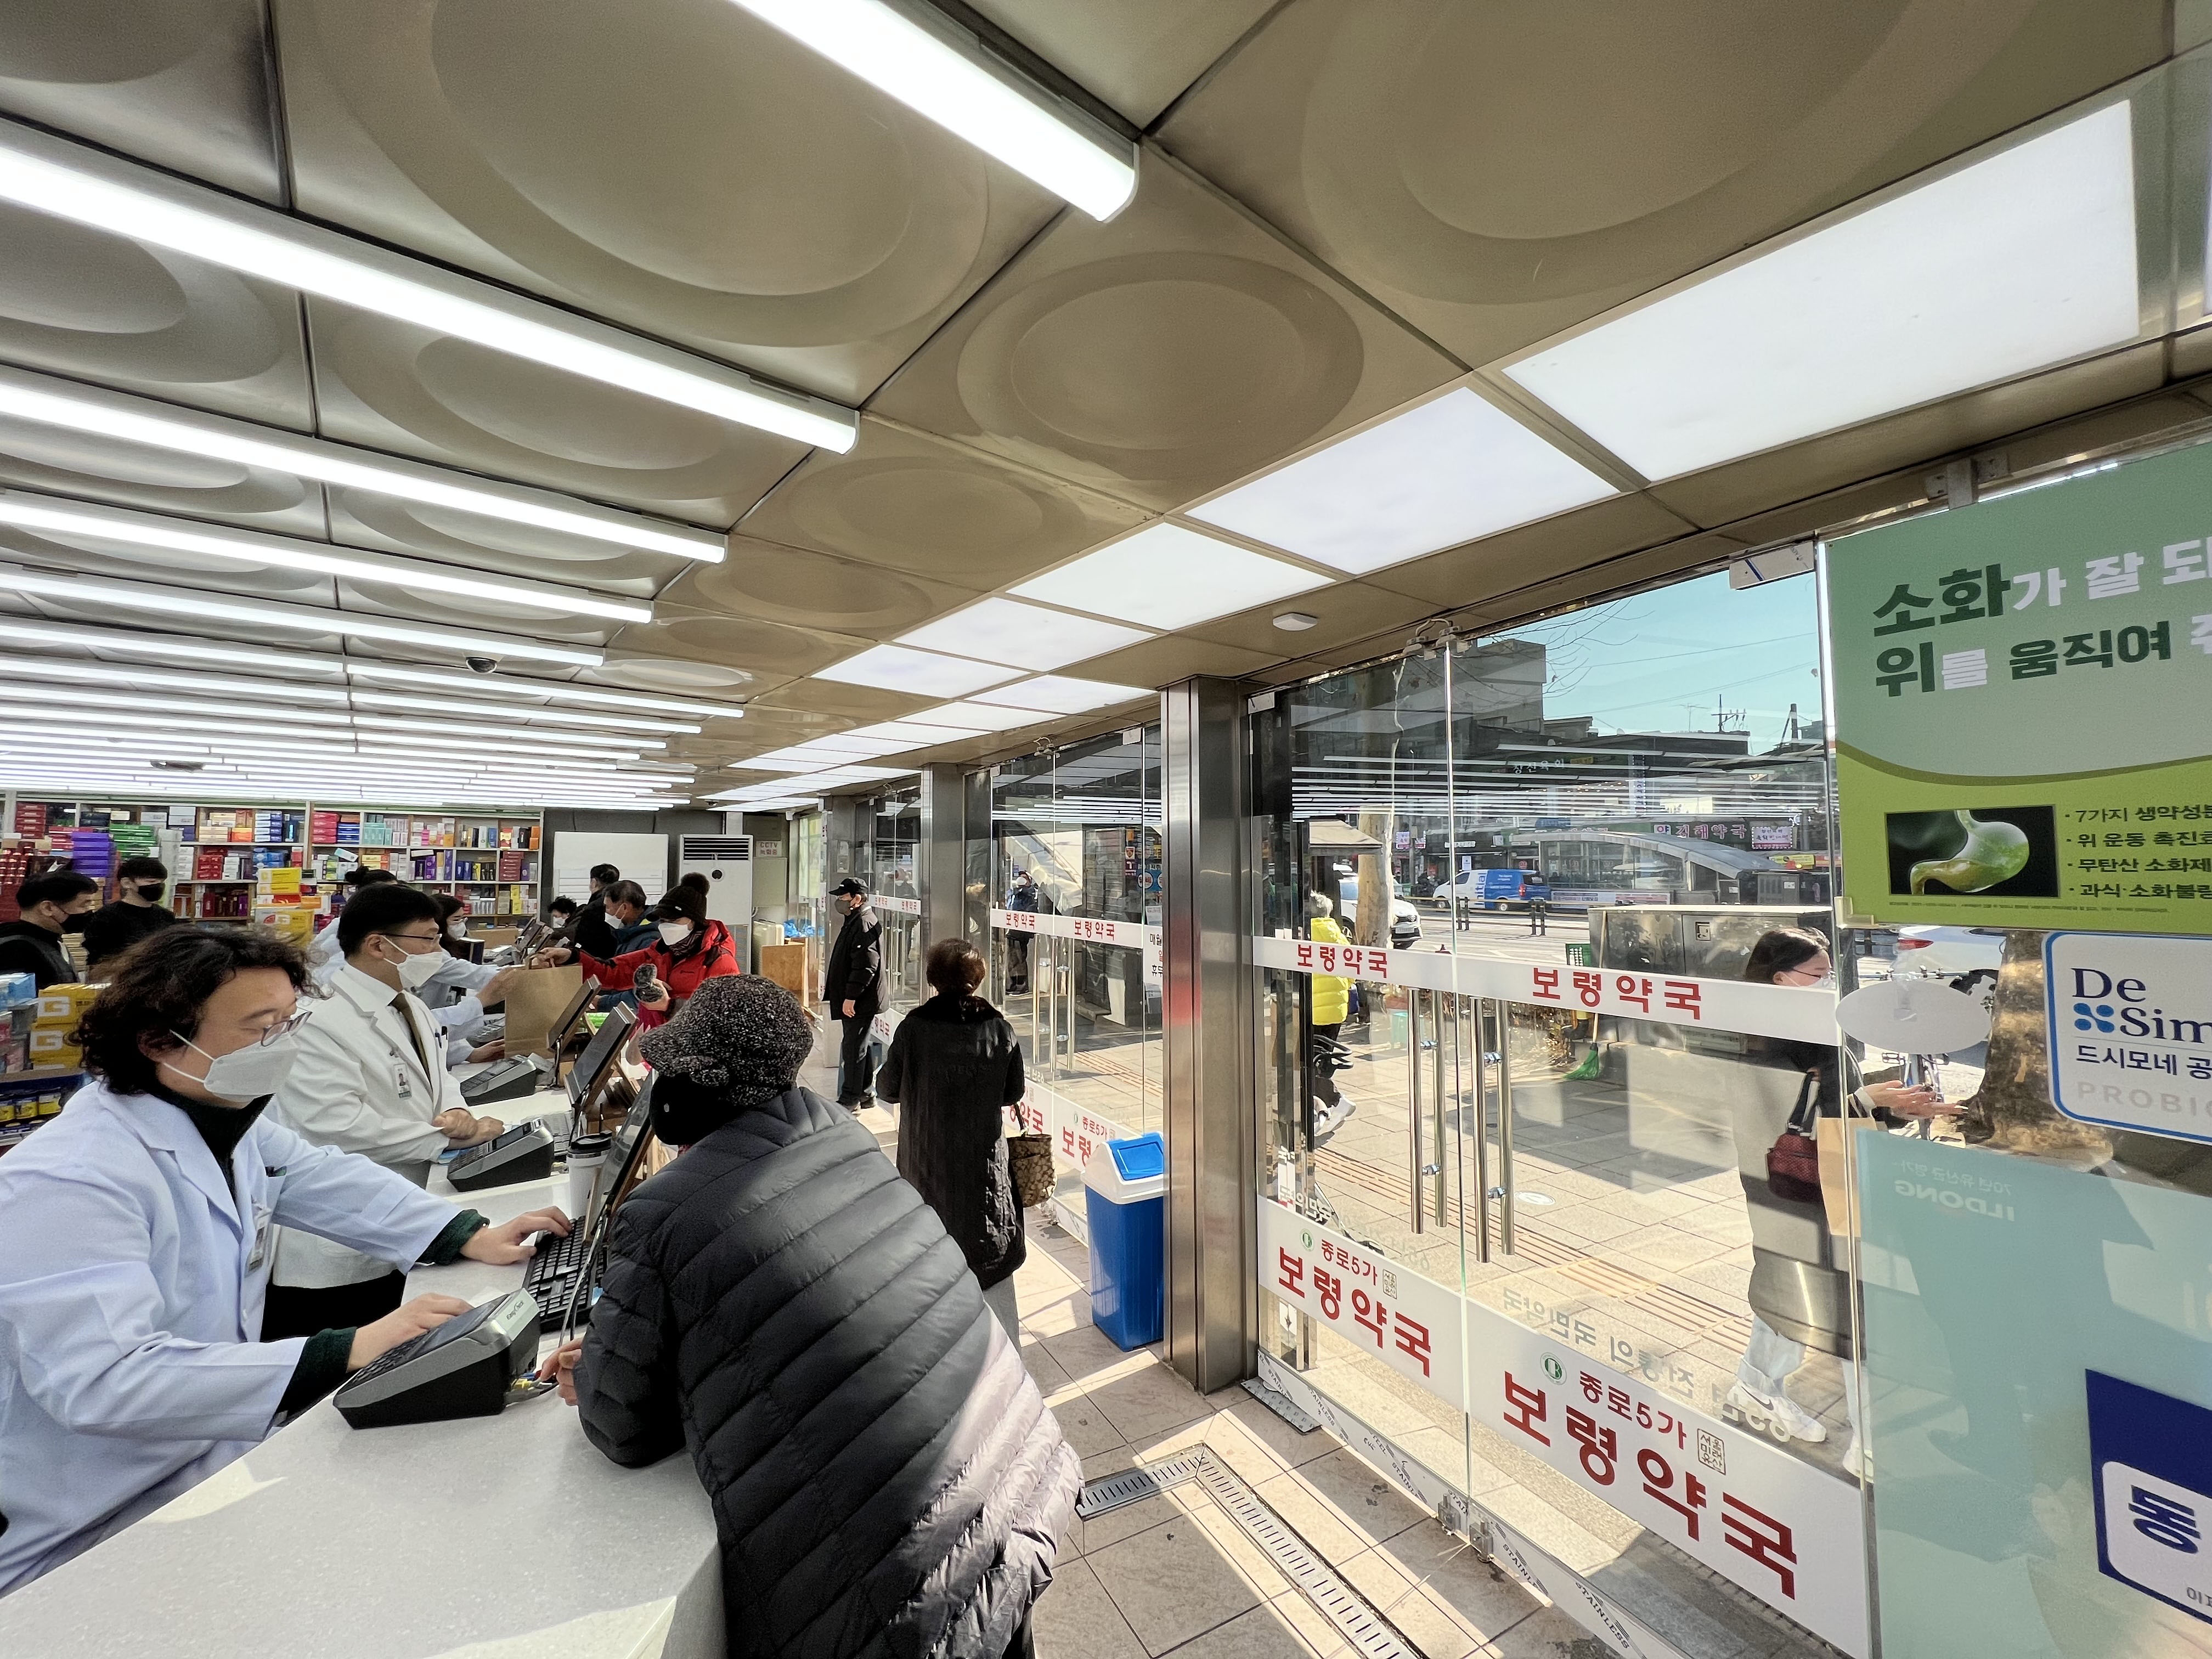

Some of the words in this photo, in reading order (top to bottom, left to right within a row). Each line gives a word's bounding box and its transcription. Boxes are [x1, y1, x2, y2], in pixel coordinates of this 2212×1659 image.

[1873, 563, 2067, 636] 소화가
[2085, 552, 2143, 600] 잘
[1876, 641, 1988, 697] 위를
[2010, 620, 2171, 680] 움직여
[2075, 807, 2128, 823] 7가지
[2077, 833, 2096, 848] 위
[2103, 833, 2146, 847] 운동
[2078, 858, 2139, 872] 무탄산
[2144, 857, 2212, 872] 소화제
[1006, 912, 1035, 930] 보령약국
[1074, 919, 1115, 941] 보령약국
[1297, 944, 1387, 978] 보령약국
[1532, 967, 1701, 1020] 보령약국
[2070, 968, 2146, 1002] De
[2076, 1045, 2177, 1076] 드시모네
[2078, 1081, 2212, 1116] PROBI
[1082, 1116, 1108, 1138] 종로5가
[1321, 1239, 1378, 1285] 종로5가
[1278, 1246, 1431, 1378] 보령약국
[1579, 1370, 1687, 1450] 종로5가
[1503, 1370, 1797, 1601] 보령약국
[1575, 1582, 1629, 1649] STAINLESS
